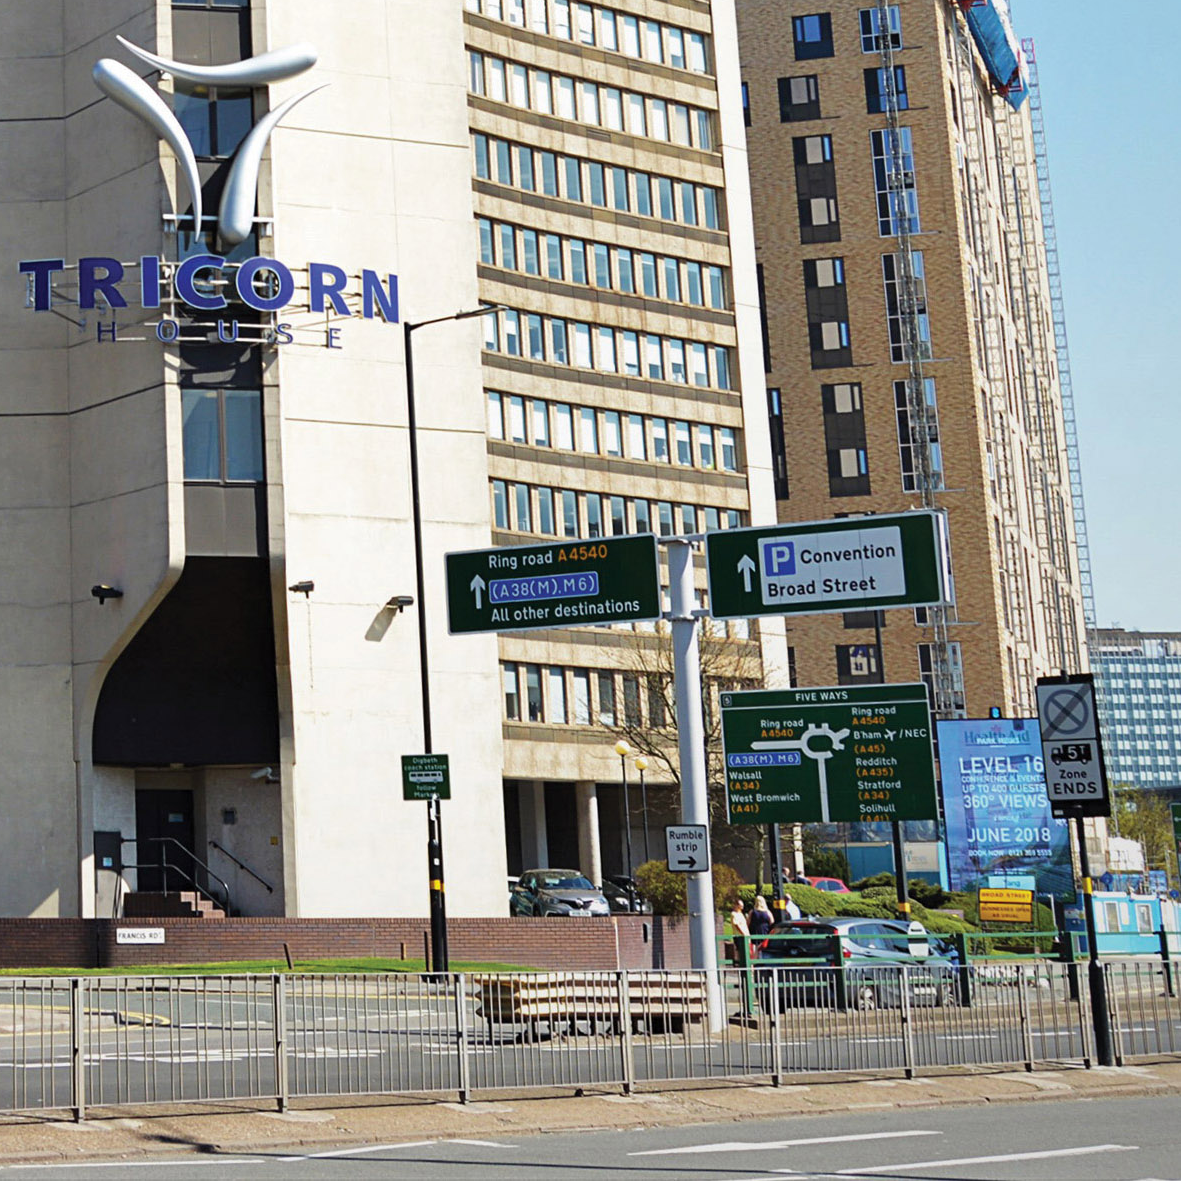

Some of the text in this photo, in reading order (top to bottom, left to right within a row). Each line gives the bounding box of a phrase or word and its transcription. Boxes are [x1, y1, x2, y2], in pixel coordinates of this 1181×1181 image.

[19, 254, 400, 324] TRICORN
[97, 320, 343, 349] HOUSE
[488, 544, 608, 569] Ring road A4540
[800, 544, 896, 564] Convention
[768, 576, 877, 597] Broad Street
[491, 599, 641, 622] All other destinations
[795, 691, 848, 702] FIVE WAYS
[851, 706, 896, 716] Ring road
[760, 719, 804, 729] Ring road
[852, 717, 886, 725] A4540
[761, 729, 794, 737] A4540
[853, 730, 882, 739] B'ham
[854, 744, 886, 754] (A45)
[856, 758, 897, 766] Redditch
[959, 756, 1044, 774] LEVEL 16
[728, 771, 762, 780] Walsall
[856, 767, 894, 777] (A435)
[1059, 770, 1087, 779] Zone
[729, 781, 760, 791] (A34)
[857, 780, 901, 789] Stratford
[962, 784, 975, 793] UP
[978, 784, 989, 793] TO
[1009, 784, 1046, 793] GUESTS
[1053, 782, 1097, 794] ENDS
[730, 793, 801, 803] West Bromwich
[858, 791, 890, 801] (A34)
[964, 794, 1048, 809] 360° VIEWS
[731, 805, 760, 814] (A41)
[859, 804, 896, 813] Solihull
[669, 830, 703, 839] Rumble
[967, 827, 1052, 843] JUNE 2018
[676, 842, 698, 852] strip
